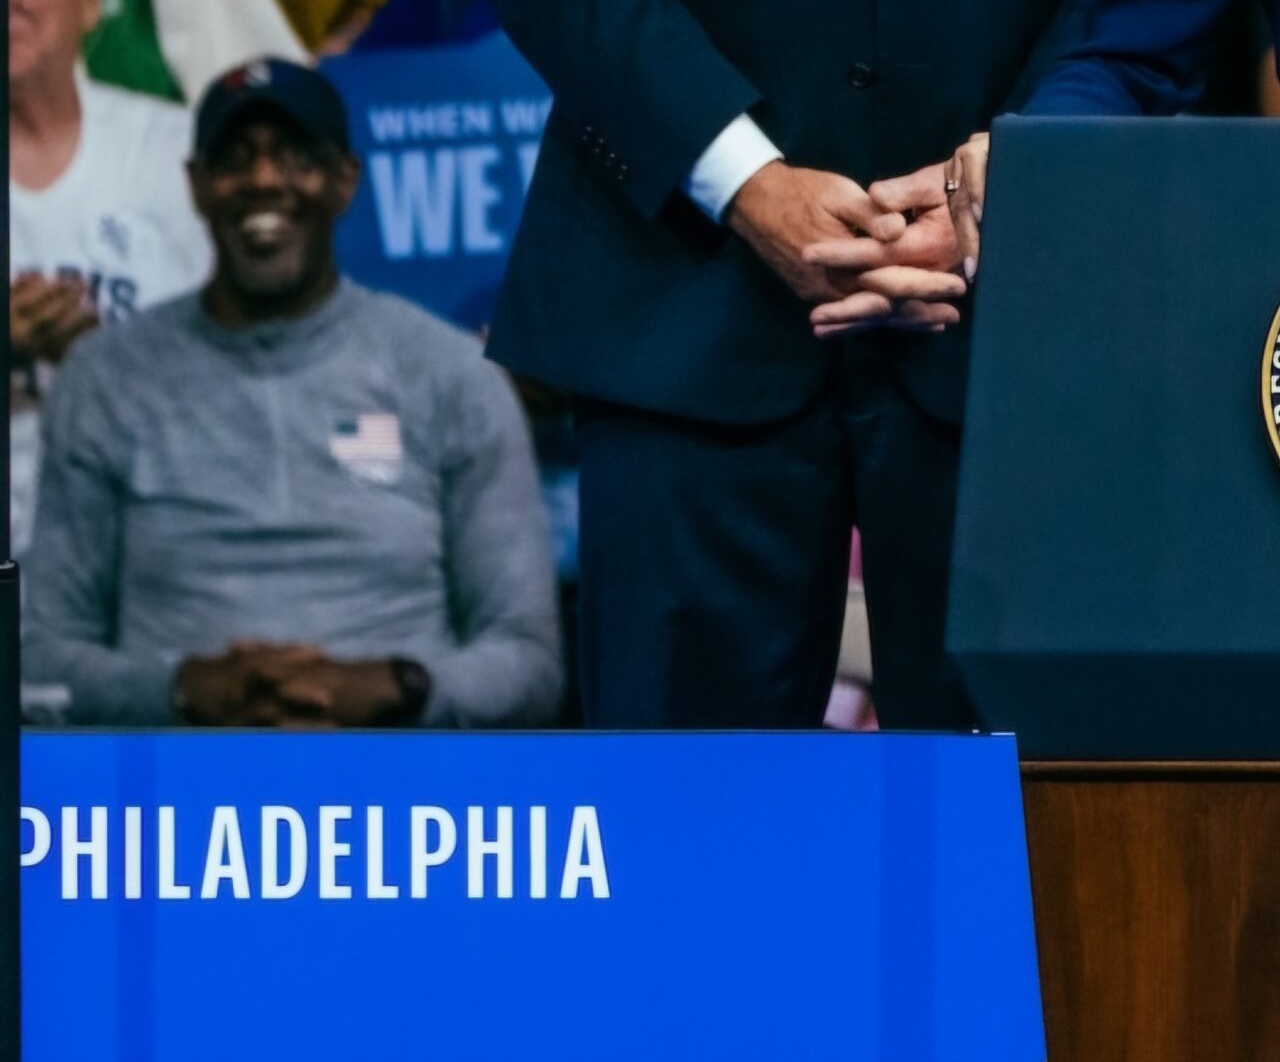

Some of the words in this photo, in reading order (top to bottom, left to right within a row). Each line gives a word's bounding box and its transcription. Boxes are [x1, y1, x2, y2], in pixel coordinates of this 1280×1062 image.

[370, 106, 493, 141] WHEN
[369, 147, 503, 258] WE
[20, 805, 611, 899] PHILADELPHIA
